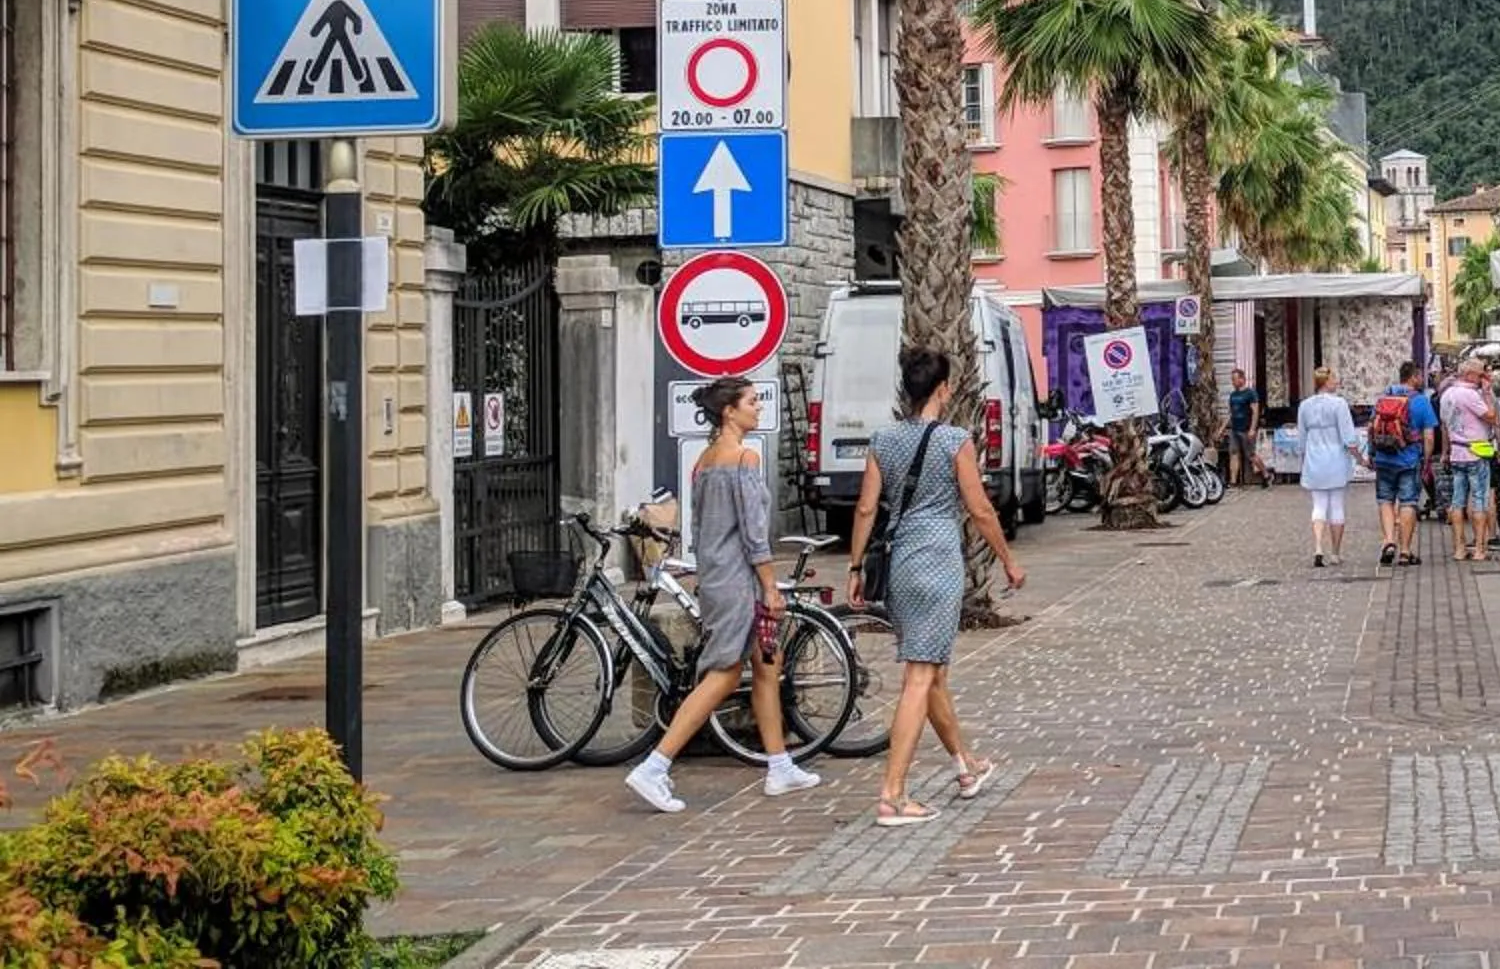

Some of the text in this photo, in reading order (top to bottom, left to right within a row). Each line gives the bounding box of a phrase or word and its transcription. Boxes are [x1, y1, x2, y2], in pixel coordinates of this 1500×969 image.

[706, 2, 737, 16] ZONA
[666, 18, 779, 33] TRAFFICO LIMITATO
[672, 110, 713, 125] 20.00
[733, 108, 774, 124] 07.00
